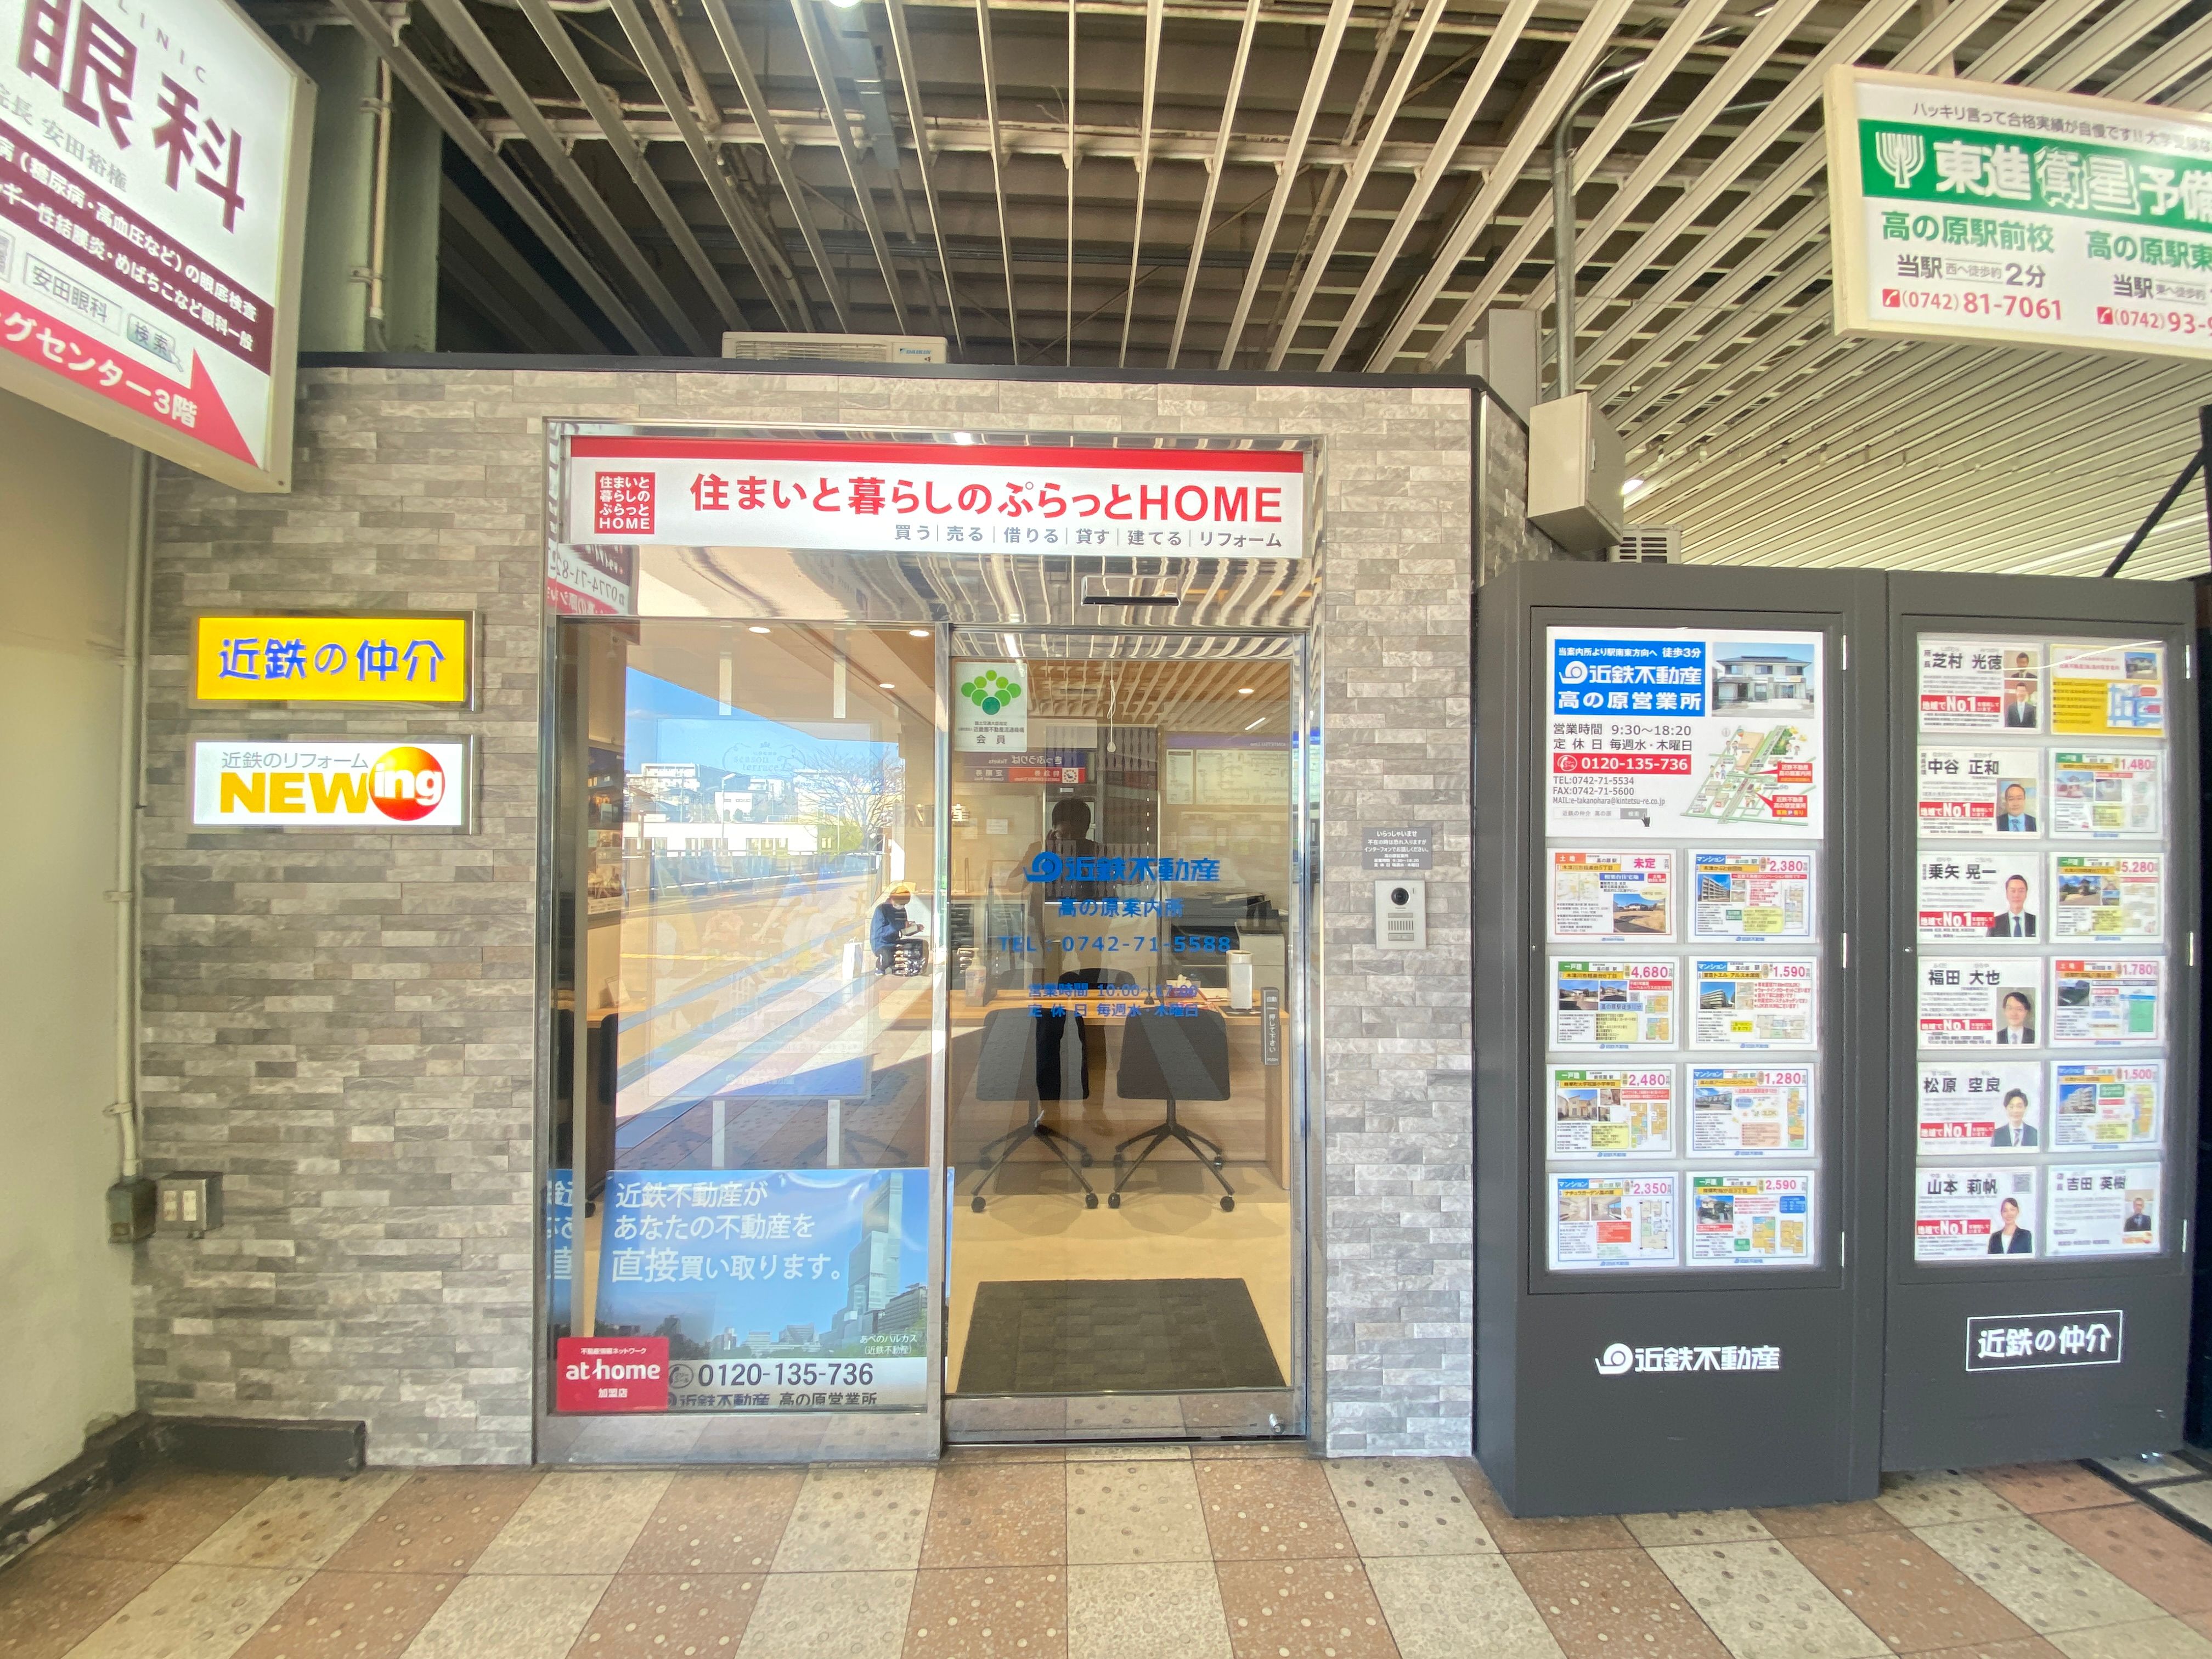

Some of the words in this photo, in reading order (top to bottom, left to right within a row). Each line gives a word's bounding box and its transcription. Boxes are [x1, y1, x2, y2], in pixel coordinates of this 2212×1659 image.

[18, 0, 245, 234] 眼科
[1882, 211, 2055, 253] 高の原駅前校
[2085, 230, 2212, 272] 高の原駅東
[0, 182, 254, 352] ギー性結膜炎・めばちこなど眼科一般
[1897, 255, 1942, 279] 当駅
[2005, 262, 2045, 288] 2分
[33, 266, 107, 323] 安田眼科
[2113, 274, 2154, 298] 当駅
[0, 312, 197, 428] グセンター3階
[599, 476, 650, 489] 住まいと
[600, 489, 650, 503] 暮らしの
[690, 473, 1283, 523] 住まいと暮らしのぷらっとHOME
[599, 517, 650, 531] HOME
[895, 524, 932, 541] 買う
[946, 525, 984, 543] 売る
[1004, 527, 1059, 544] 借りる
[1075, 528, 1110, 545] 貸す
[1127, 529, 1182, 546] 建てる
[1199, 531, 1283, 548] リフォーム
[218, 638, 445, 681] 近鉄の仲介
[1662, 647, 1702, 658] 徒歩3分
[1932, 652, 1963, 669] 芝村
[1972, 654, 2002, 670] 光徳
[1589, 666, 1702, 685] 近鉄不動産
[1558, 691, 1701, 710] 高の原営業所
[1553, 723, 1602, 736] 営業時間
[1611, 725, 1691, 736] 9:30～18:20
[1610, 739, 1692, 752] 毎週水・木曜日
[222, 752, 369, 769] 近鉄のリフォーム
[1581, 757, 1688, 771] 0120-135-736
[1928, 759, 1959, 775] 中谷
[1968, 759, 1999, 775] 正和
[220, 763, 442, 814] NEWing
[1554, 776, 1634, 785] TEL:0742-71-5534
[1553, 787, 1634, 795] FAX:0742-71-5600
[1066, 857, 1221, 882] 近鉄不動産
[1634, 858, 1656, 869] 未定
[1929, 864, 1959, 879] 乗矢
[1058, 897, 1184, 918] 高の原案内所
[1631, 967, 1668, 978] 4,680
[1928, 969, 1960, 985] 福田
[1969, 969, 2000, 985] 大也
[1028, 983, 1088, 997] 営業時間
[1629, 1074, 1665, 1086] 2,480
[1924, 1077, 1957, 1093] 松原
[1968, 1077, 2000, 1093] 空良
[616, 1181, 768, 1209] 近鉄不動産が
[1928, 1179, 1958, 1194] 山本
[614, 1213, 815, 1240] あなたの不動産を
[612, 1246, 840, 1283] 直接買い取ります。
[1977, 1323, 2112, 1359] 近鉄の仲介
[1634, 1344, 1780, 1372] 近鉄不動産
[698, 1363, 873, 1386] 0120-135-736
[598, 1388, 628, 1398] 加盟店
[679, 1392, 770, 1407] 近鉄不動産
[780, 1392, 877, 1406] 高の原営業所
